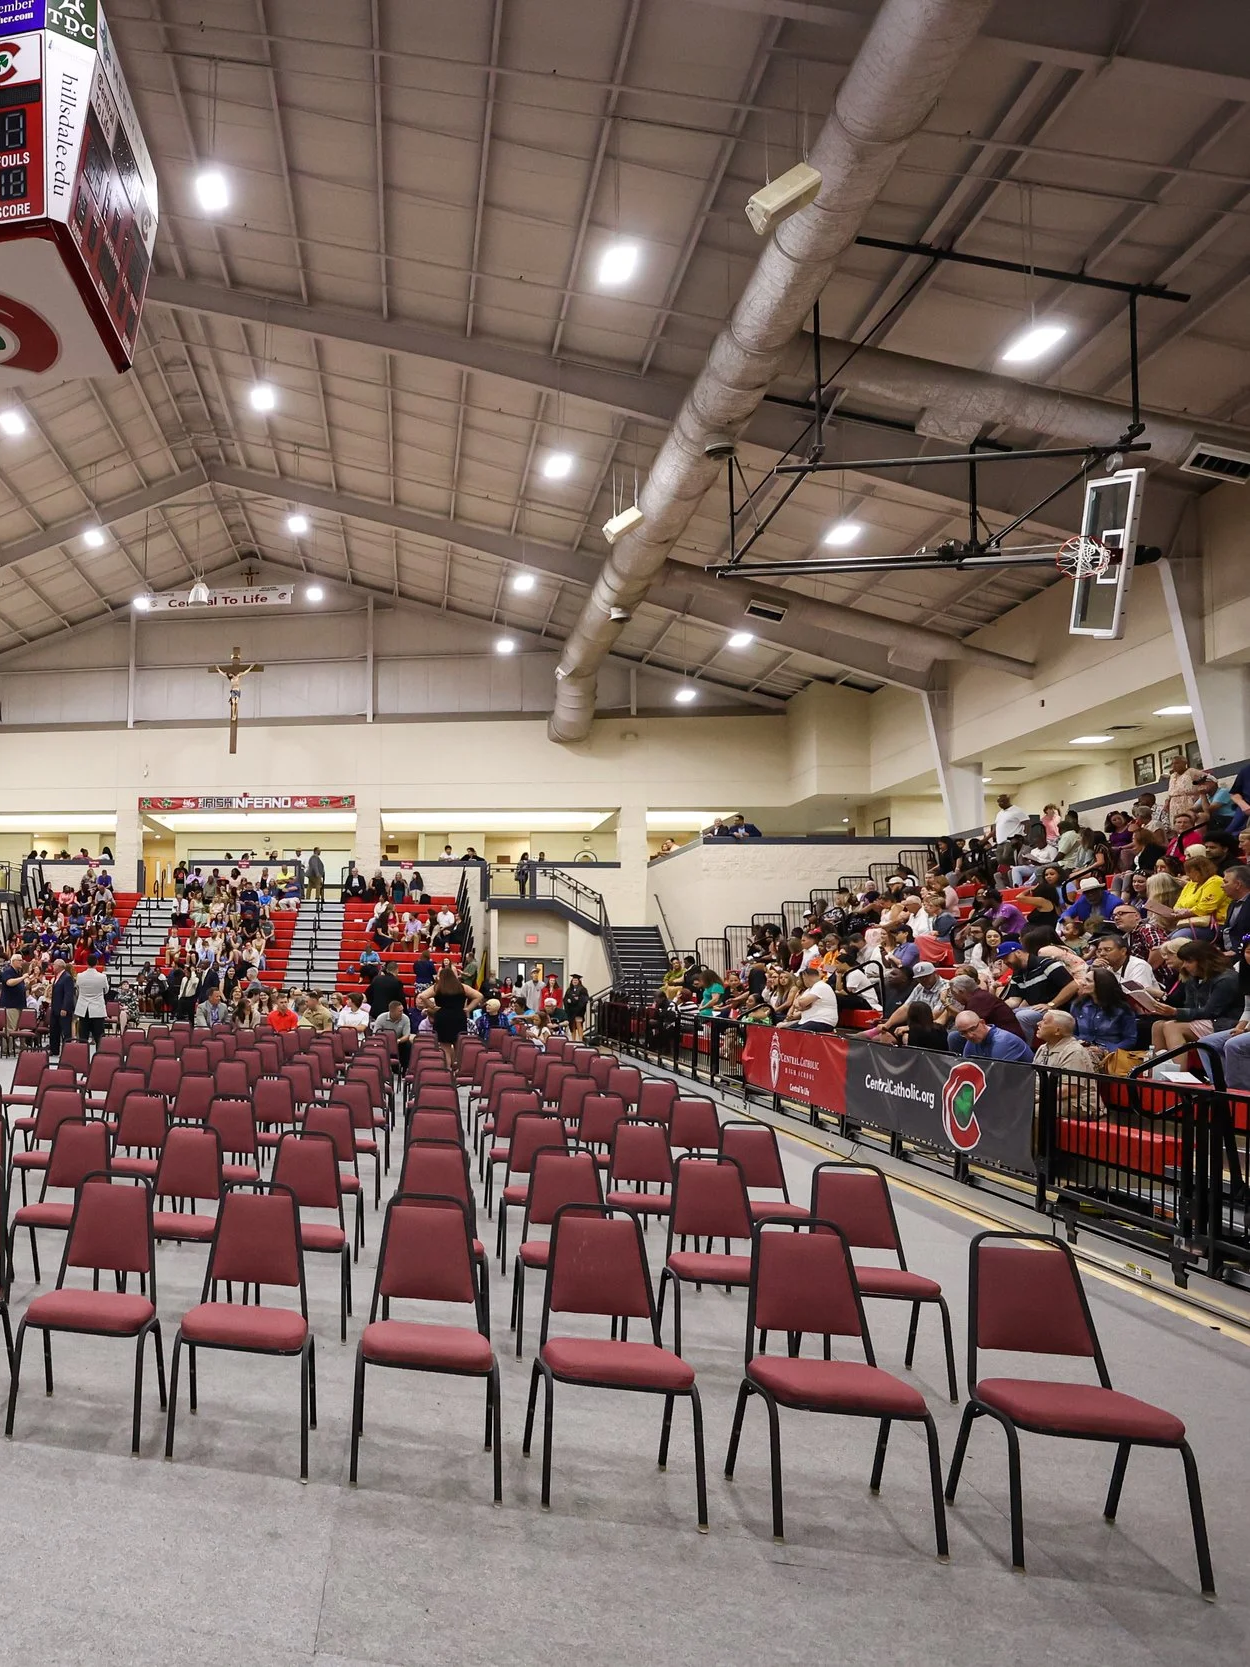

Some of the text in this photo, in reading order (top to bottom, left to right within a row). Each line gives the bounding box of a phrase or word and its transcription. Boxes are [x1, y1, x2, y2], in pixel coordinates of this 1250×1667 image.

[47, 7, 95, 40] TDC
[53, 72, 78, 197] hillsdale.edu
[168, 597, 217, 608] Ceal
[222, 596, 238, 605] To
[243, 594, 268, 603] Life
[203, 797, 232, 809] IRISH
[232, 797, 291, 809] INFERNO
[780, 1053, 801, 1066] CENTRAL
[865, 1074, 935, 1109] CentralCatholic.org
